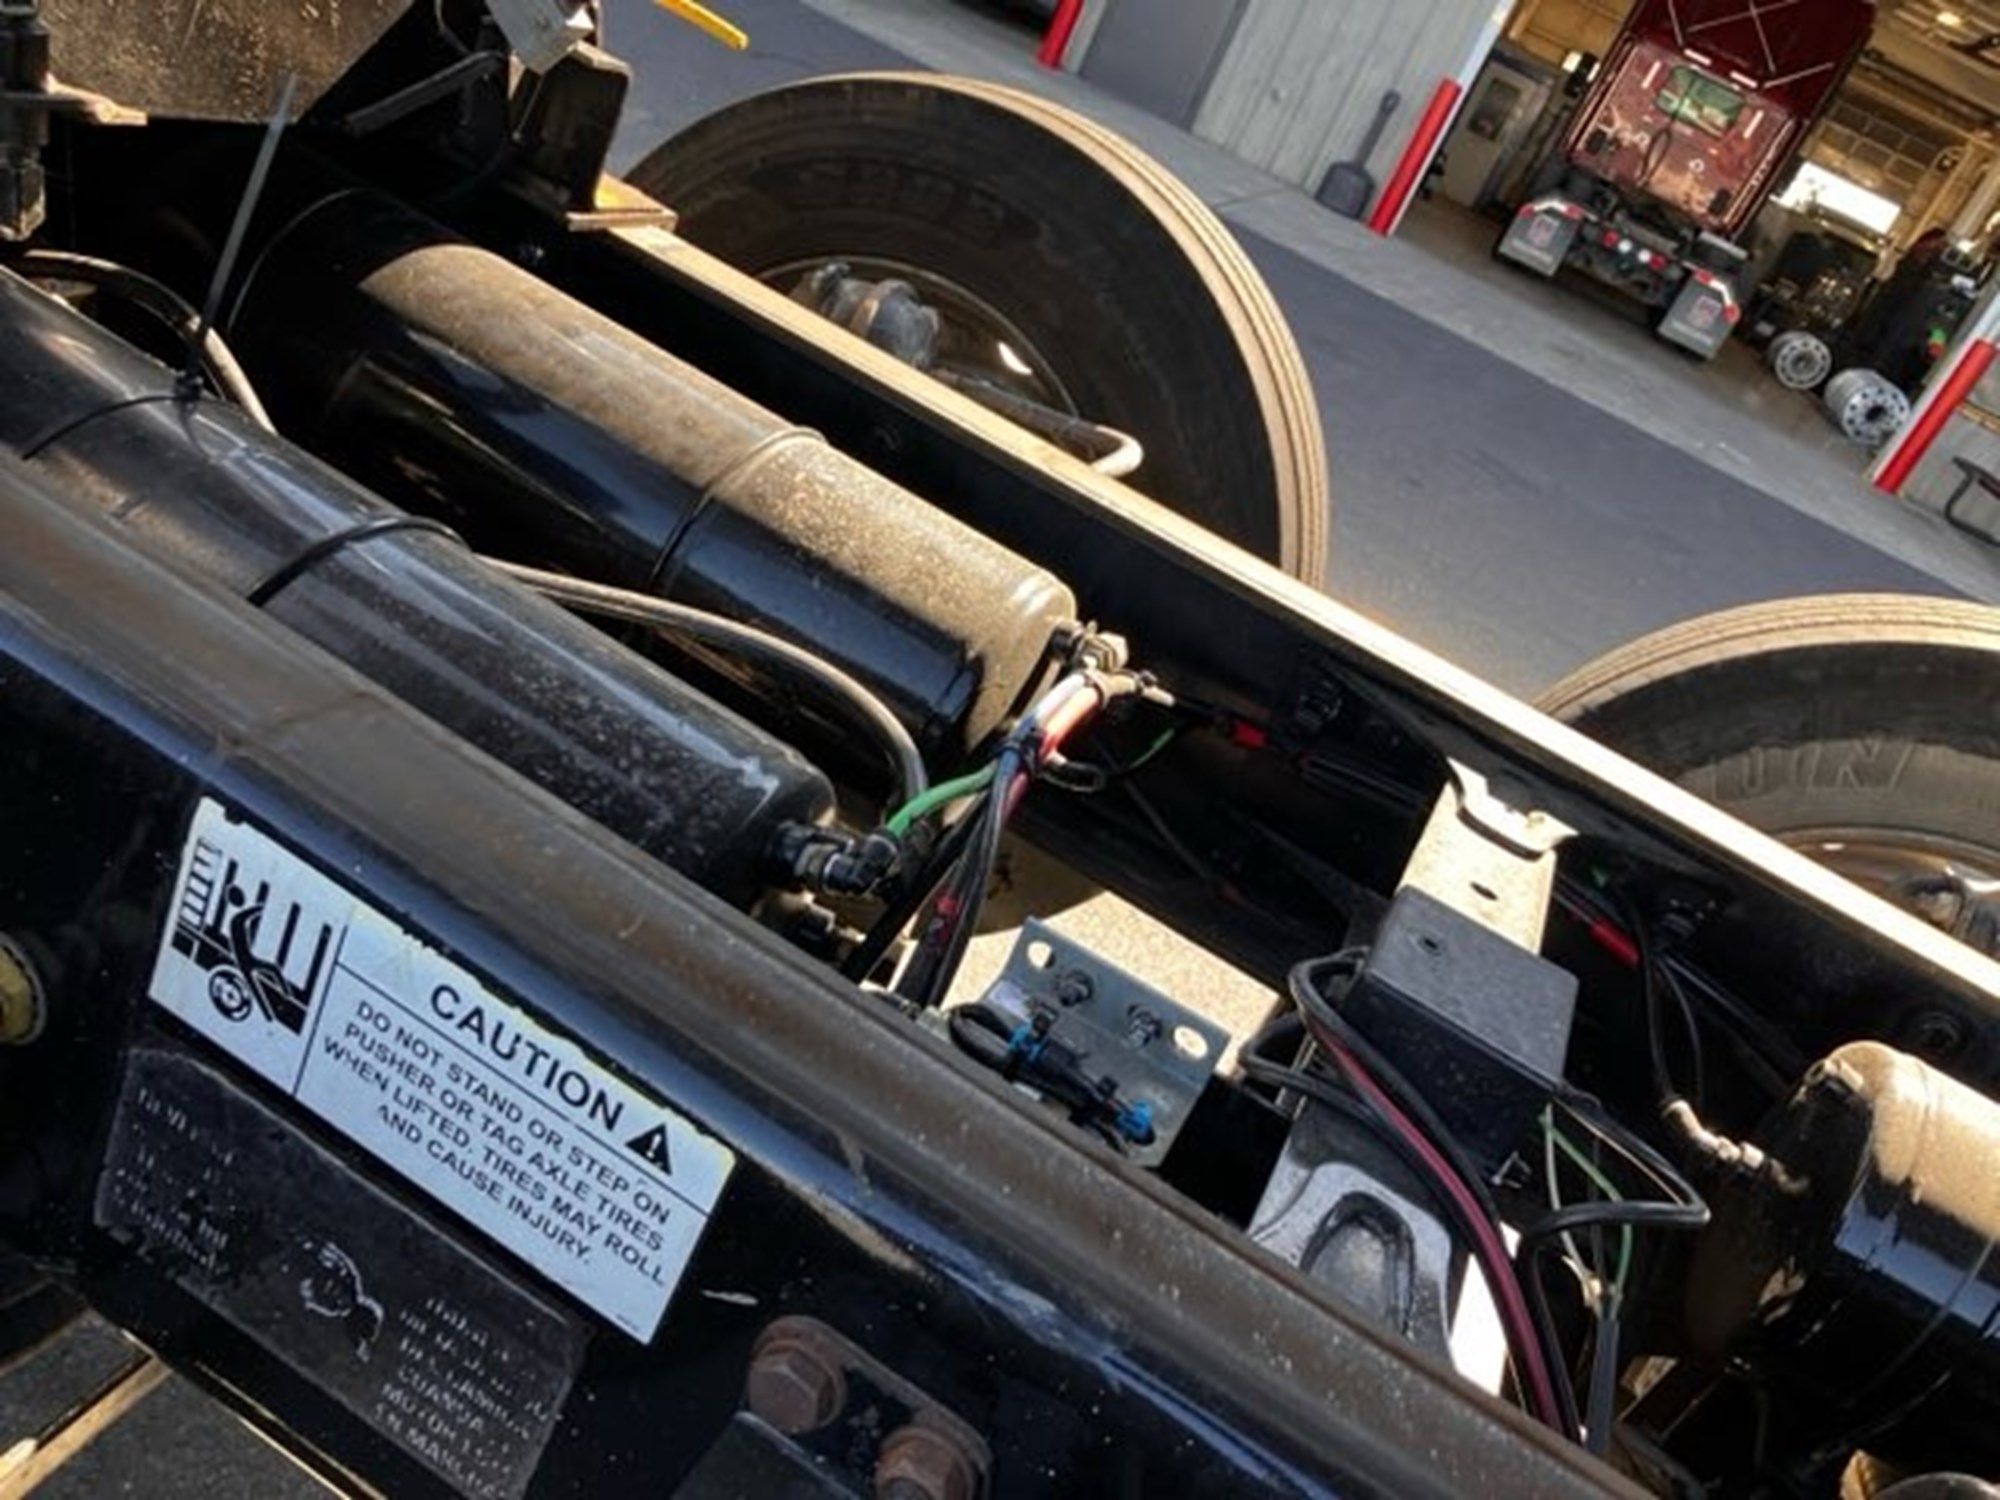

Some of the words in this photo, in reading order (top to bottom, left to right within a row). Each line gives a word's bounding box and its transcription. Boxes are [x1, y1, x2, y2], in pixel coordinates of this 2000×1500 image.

[323, 1036, 390, 1092] WHEN
[483, 1145, 547, 1202] TIRES
[551, 1196, 602, 1237] MAY
[604, 1233, 665, 1286] ROLL
[344, 1022, 436, 1095] PUSHER
[440, 1089, 475, 1122] OR
[480, 1113, 524, 1157] TAG
[529, 1151, 592, 1201] AXLE
[597, 1194, 664, 1252] TIRES
[356, 1000, 391, 1033] DO
[396, 1027, 444, 1067] NOT
[447, 1063, 523, 1123] STAND
[528, 1118, 564, 1153] OR
[568, 1145, 630, 1193] STEP
[633, 1190, 670, 1225] ON
[431, 984, 624, 1131] CAUTION
[378, 1104, 422, 1143] AND
[427, 1140, 503, 1201] CAUSE
[507, 1195, 591, 1265] INJURY.
